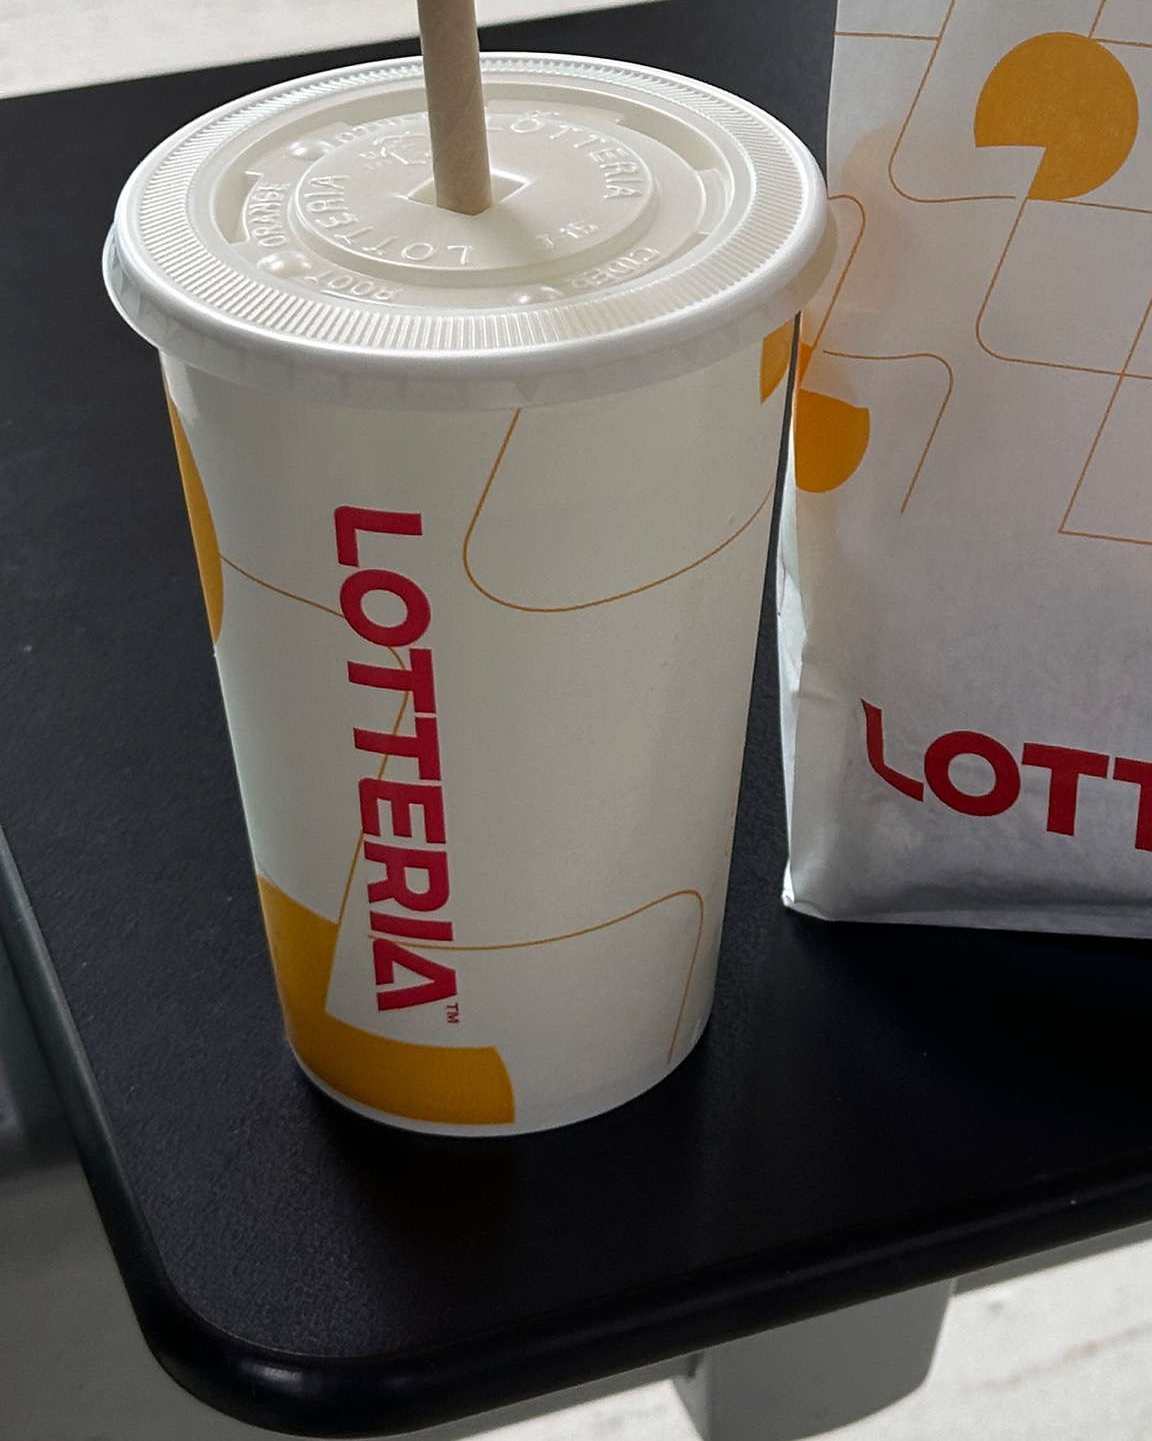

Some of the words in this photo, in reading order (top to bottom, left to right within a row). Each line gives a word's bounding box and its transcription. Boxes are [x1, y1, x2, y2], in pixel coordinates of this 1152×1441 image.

[248, 180, 292, 248] ORANGE
[304, 175, 473, 266] LOTTERIA
[333, 505, 458, 1012] LOTTERIA
